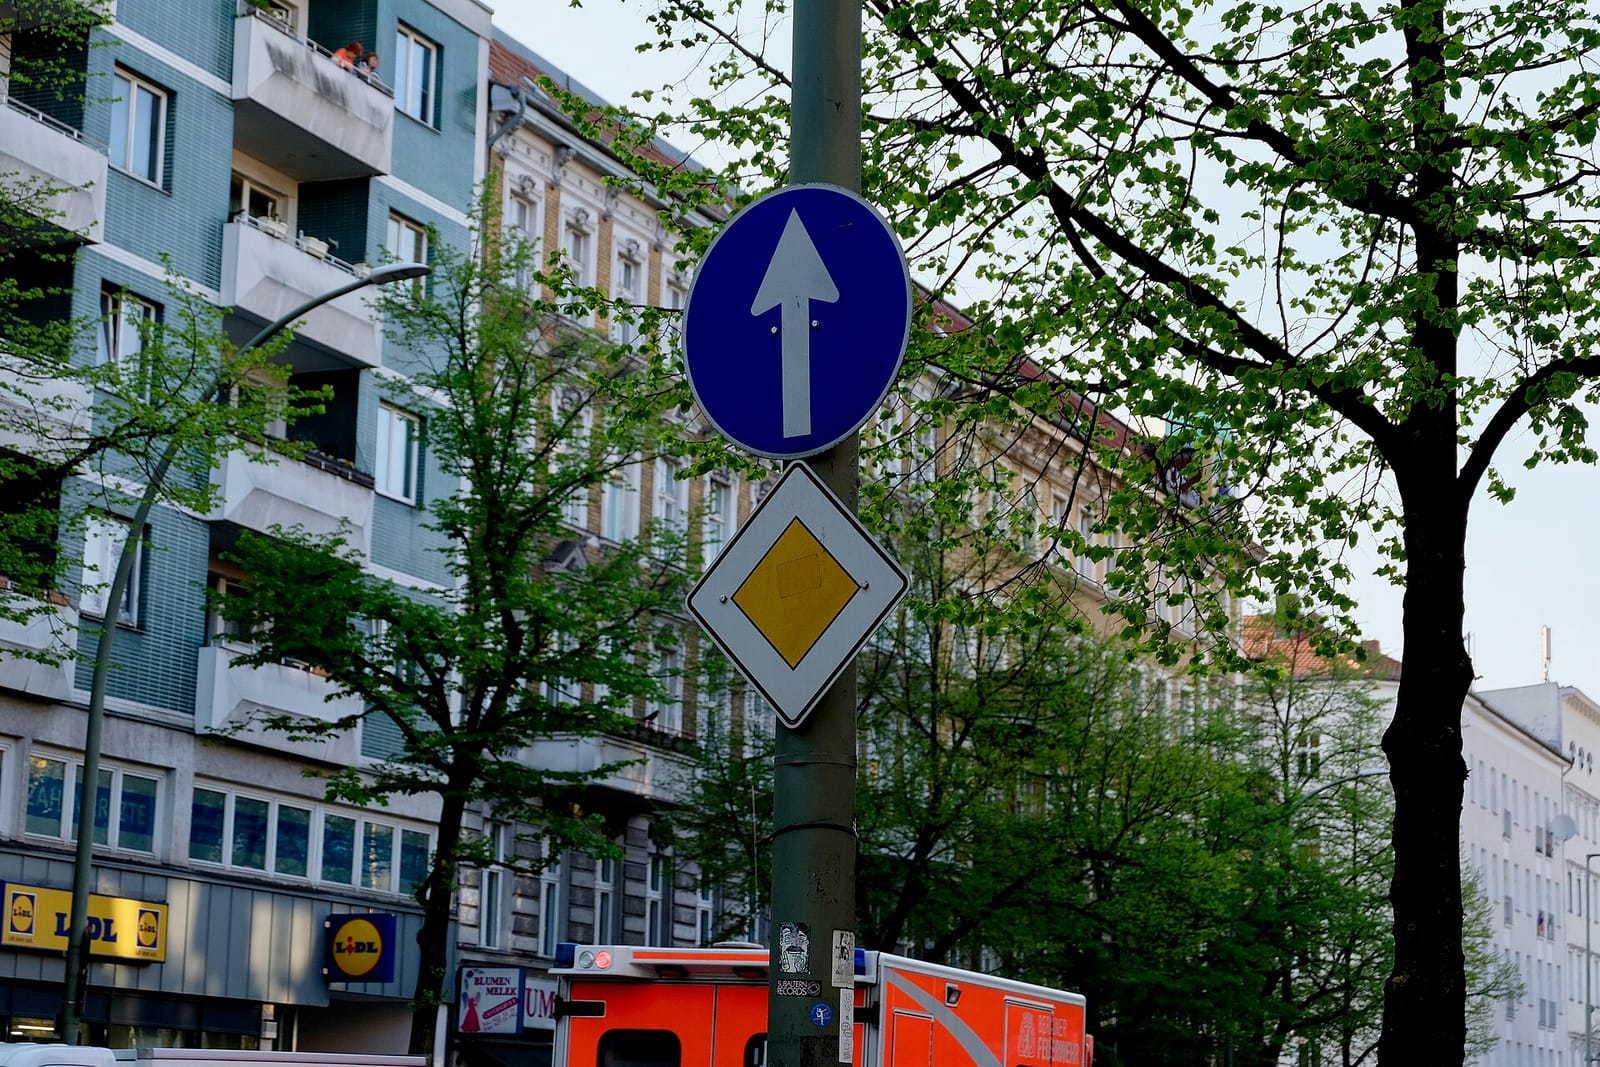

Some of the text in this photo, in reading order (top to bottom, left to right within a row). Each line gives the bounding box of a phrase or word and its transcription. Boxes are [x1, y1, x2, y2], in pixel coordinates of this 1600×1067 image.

[54, 912, 118, 943] LDL
[474, 977, 511, 986] BLUMEN
[486, 986, 517, 996] MELEK
